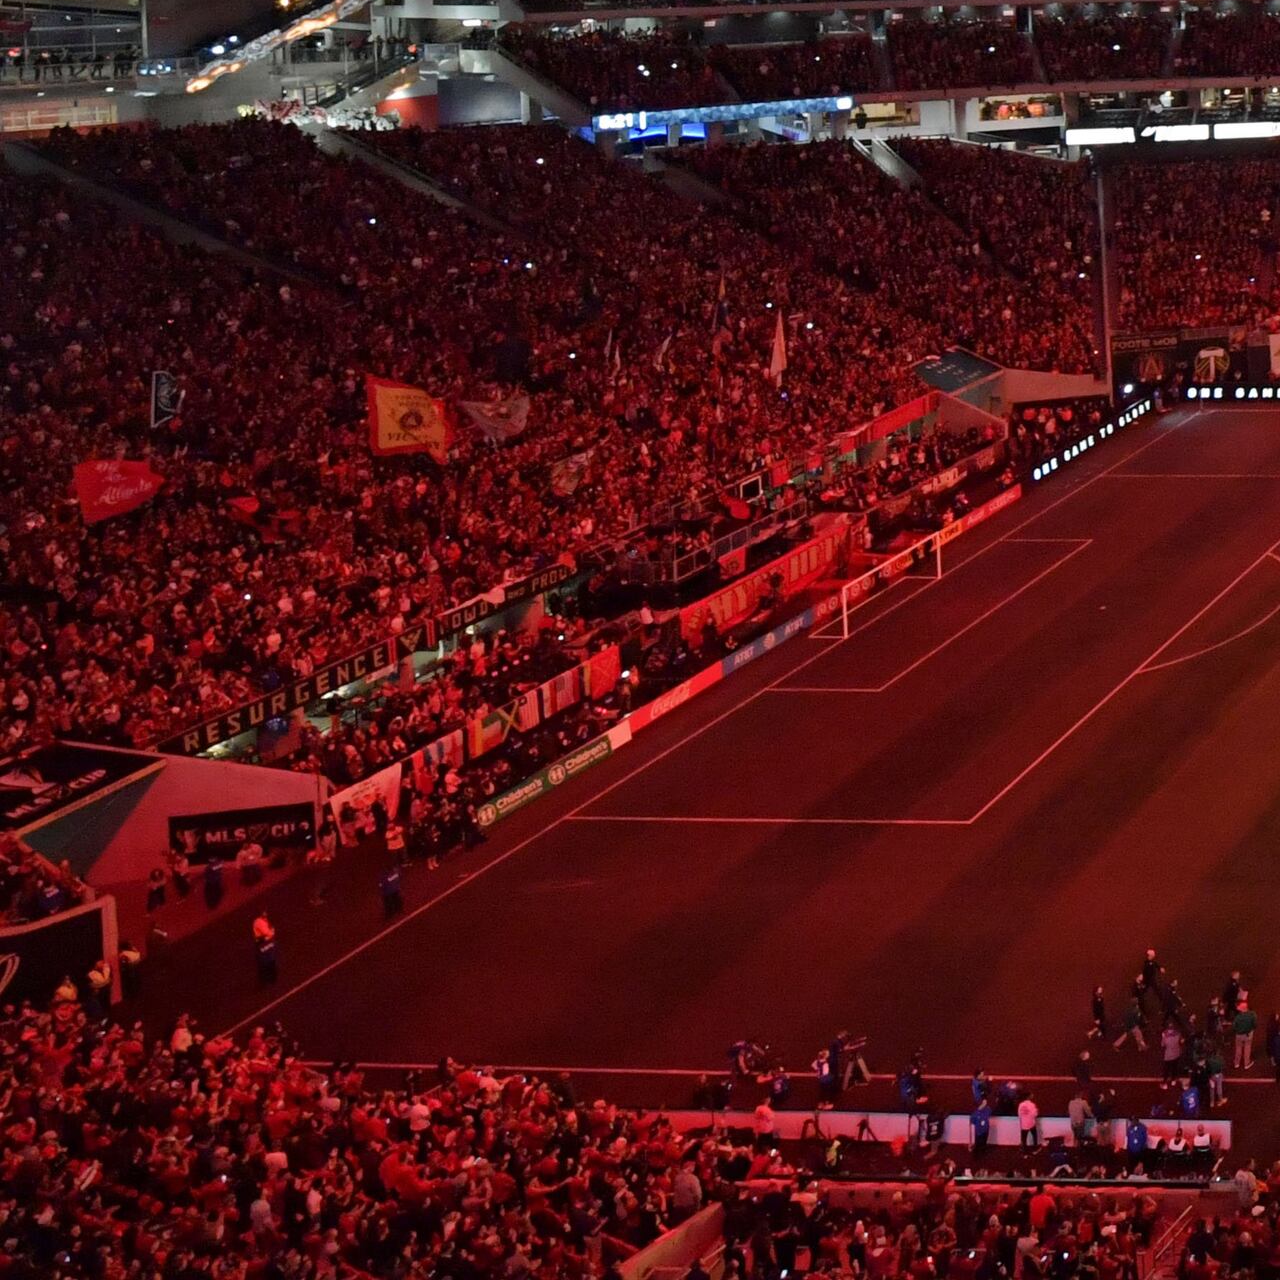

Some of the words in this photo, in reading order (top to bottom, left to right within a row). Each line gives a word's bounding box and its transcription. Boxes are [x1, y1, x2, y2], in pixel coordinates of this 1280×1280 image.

[1187, 387, 1223, 399] ONE
[1033, 457, 1058, 481] ONE
[1063, 435, 1095, 462] GAME
[1099, 423, 1114, 439] TO
[1118, 400, 1151, 427] GLORY
[734, 646, 756, 667] AT&T
[784, 616, 806, 636] AT&T
[183, 645, 386, 753] RESURGENCE
[68, 768, 107, 790] CUP
[496, 777, 544, 810] Children's
[565, 740, 610, 770] Children's
[205, 826, 248, 844] MLS
